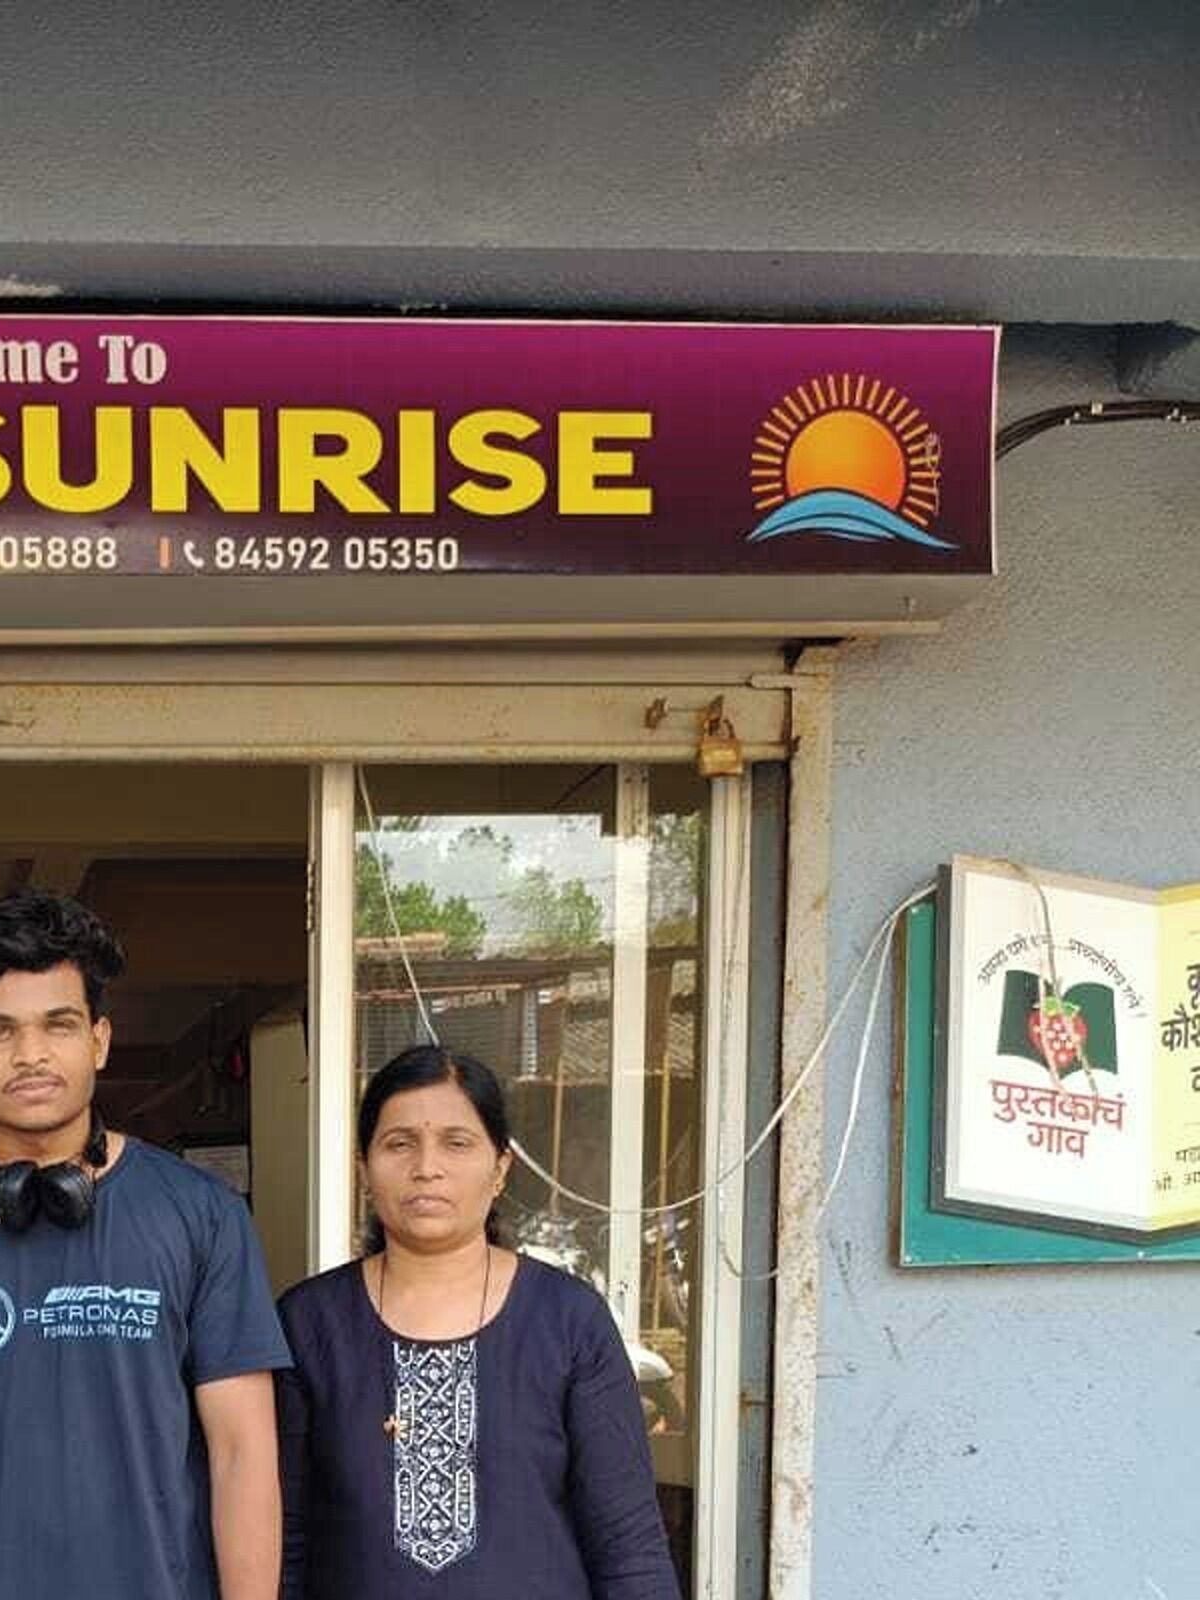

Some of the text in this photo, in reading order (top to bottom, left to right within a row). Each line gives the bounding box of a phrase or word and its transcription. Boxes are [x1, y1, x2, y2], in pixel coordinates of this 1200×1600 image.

[98, 334, 167, 385] To
[0, 537, 118, 570] 05888
[215, 537, 459, 570] 84592 05350
[1027, 1122, 1089, 1159] गाव
[78, 1285, 161, 1306] AMG
[23, 1304, 159, 1326] PETRONAS
